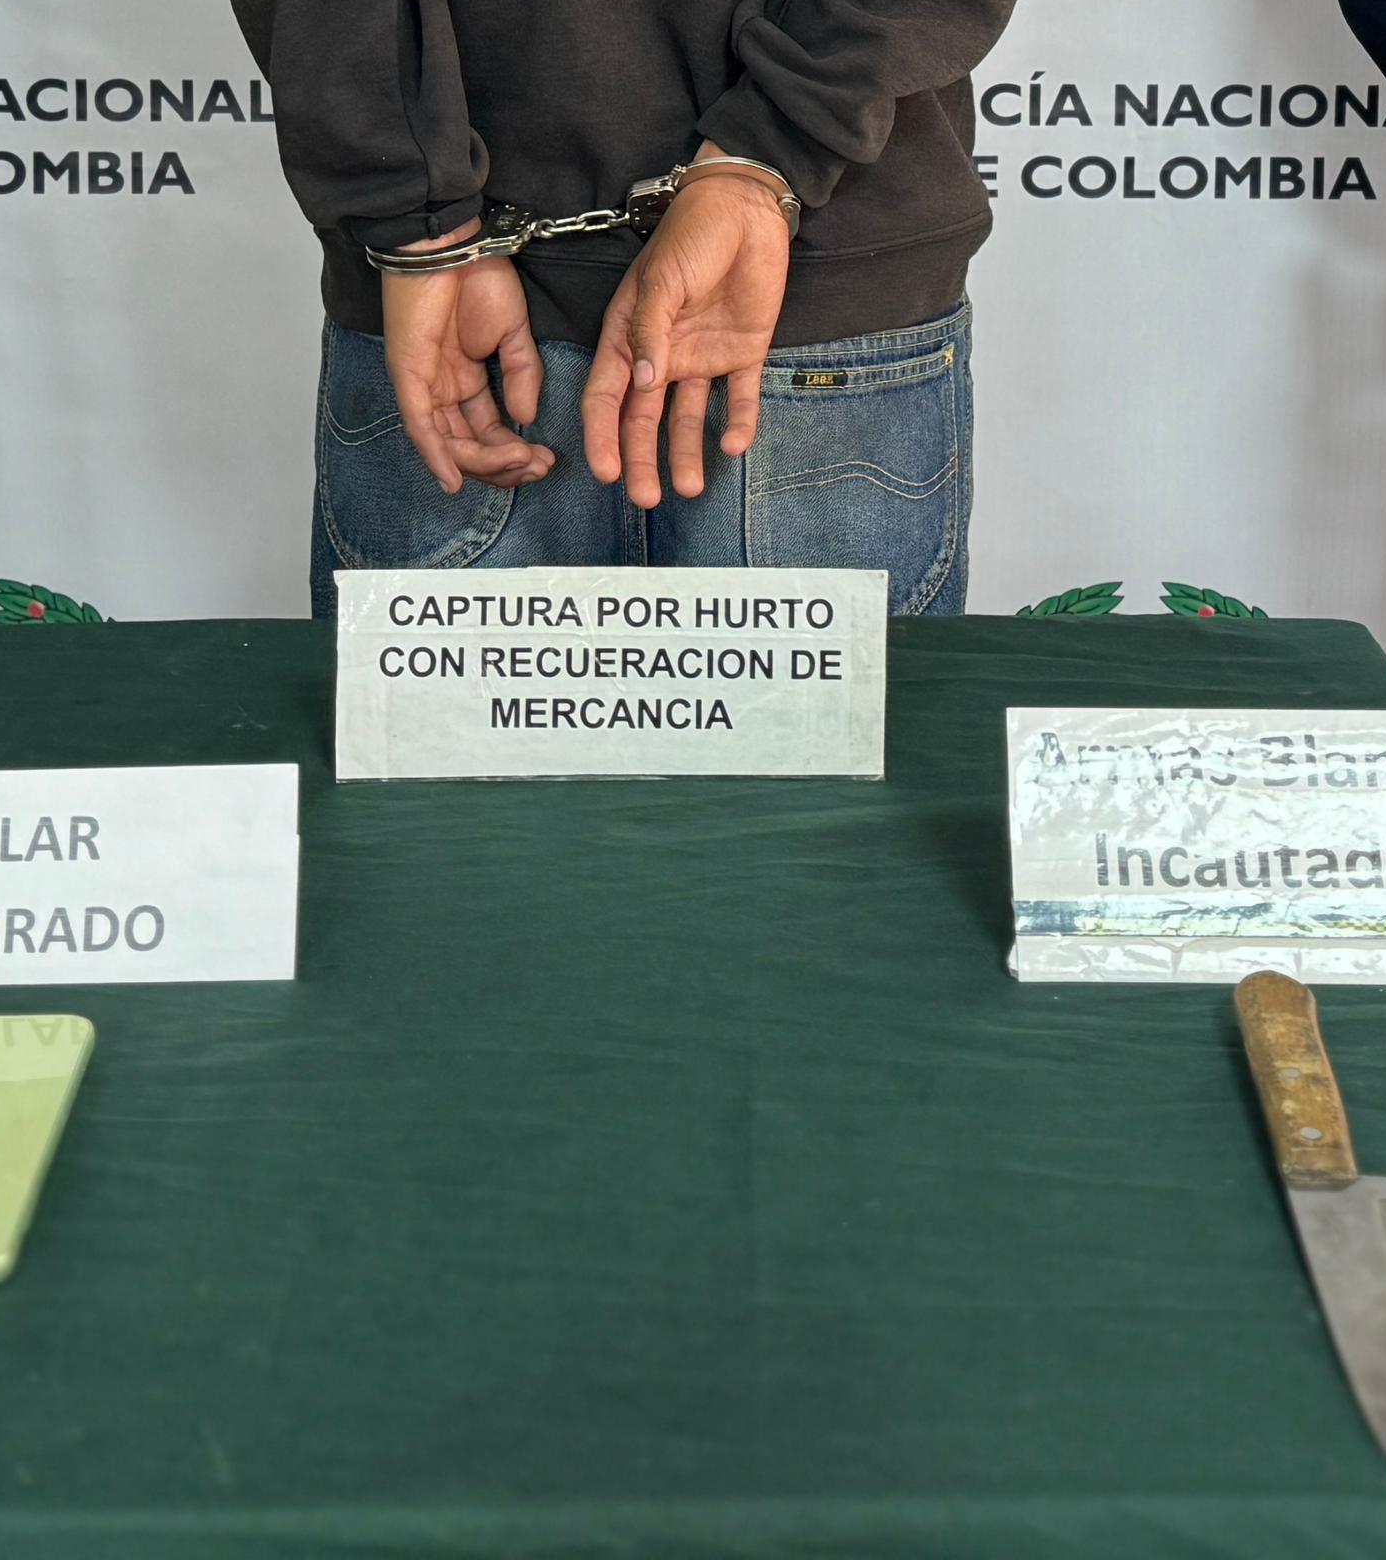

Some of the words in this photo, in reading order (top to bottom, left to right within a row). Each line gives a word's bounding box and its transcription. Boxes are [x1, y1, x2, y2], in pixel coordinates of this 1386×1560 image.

[1019, 154, 1378, 201] COLOMBIA
[388, 594, 583, 628] CAPTURA
[596, 595, 681, 628] POR
[694, 597, 836, 630] HURTO
[378, 645, 465, 679] CON
[480, 645, 774, 680] RECUERACION
[790, 649, 844, 681] DE
[489, 696, 734, 731] MERCANCIA
